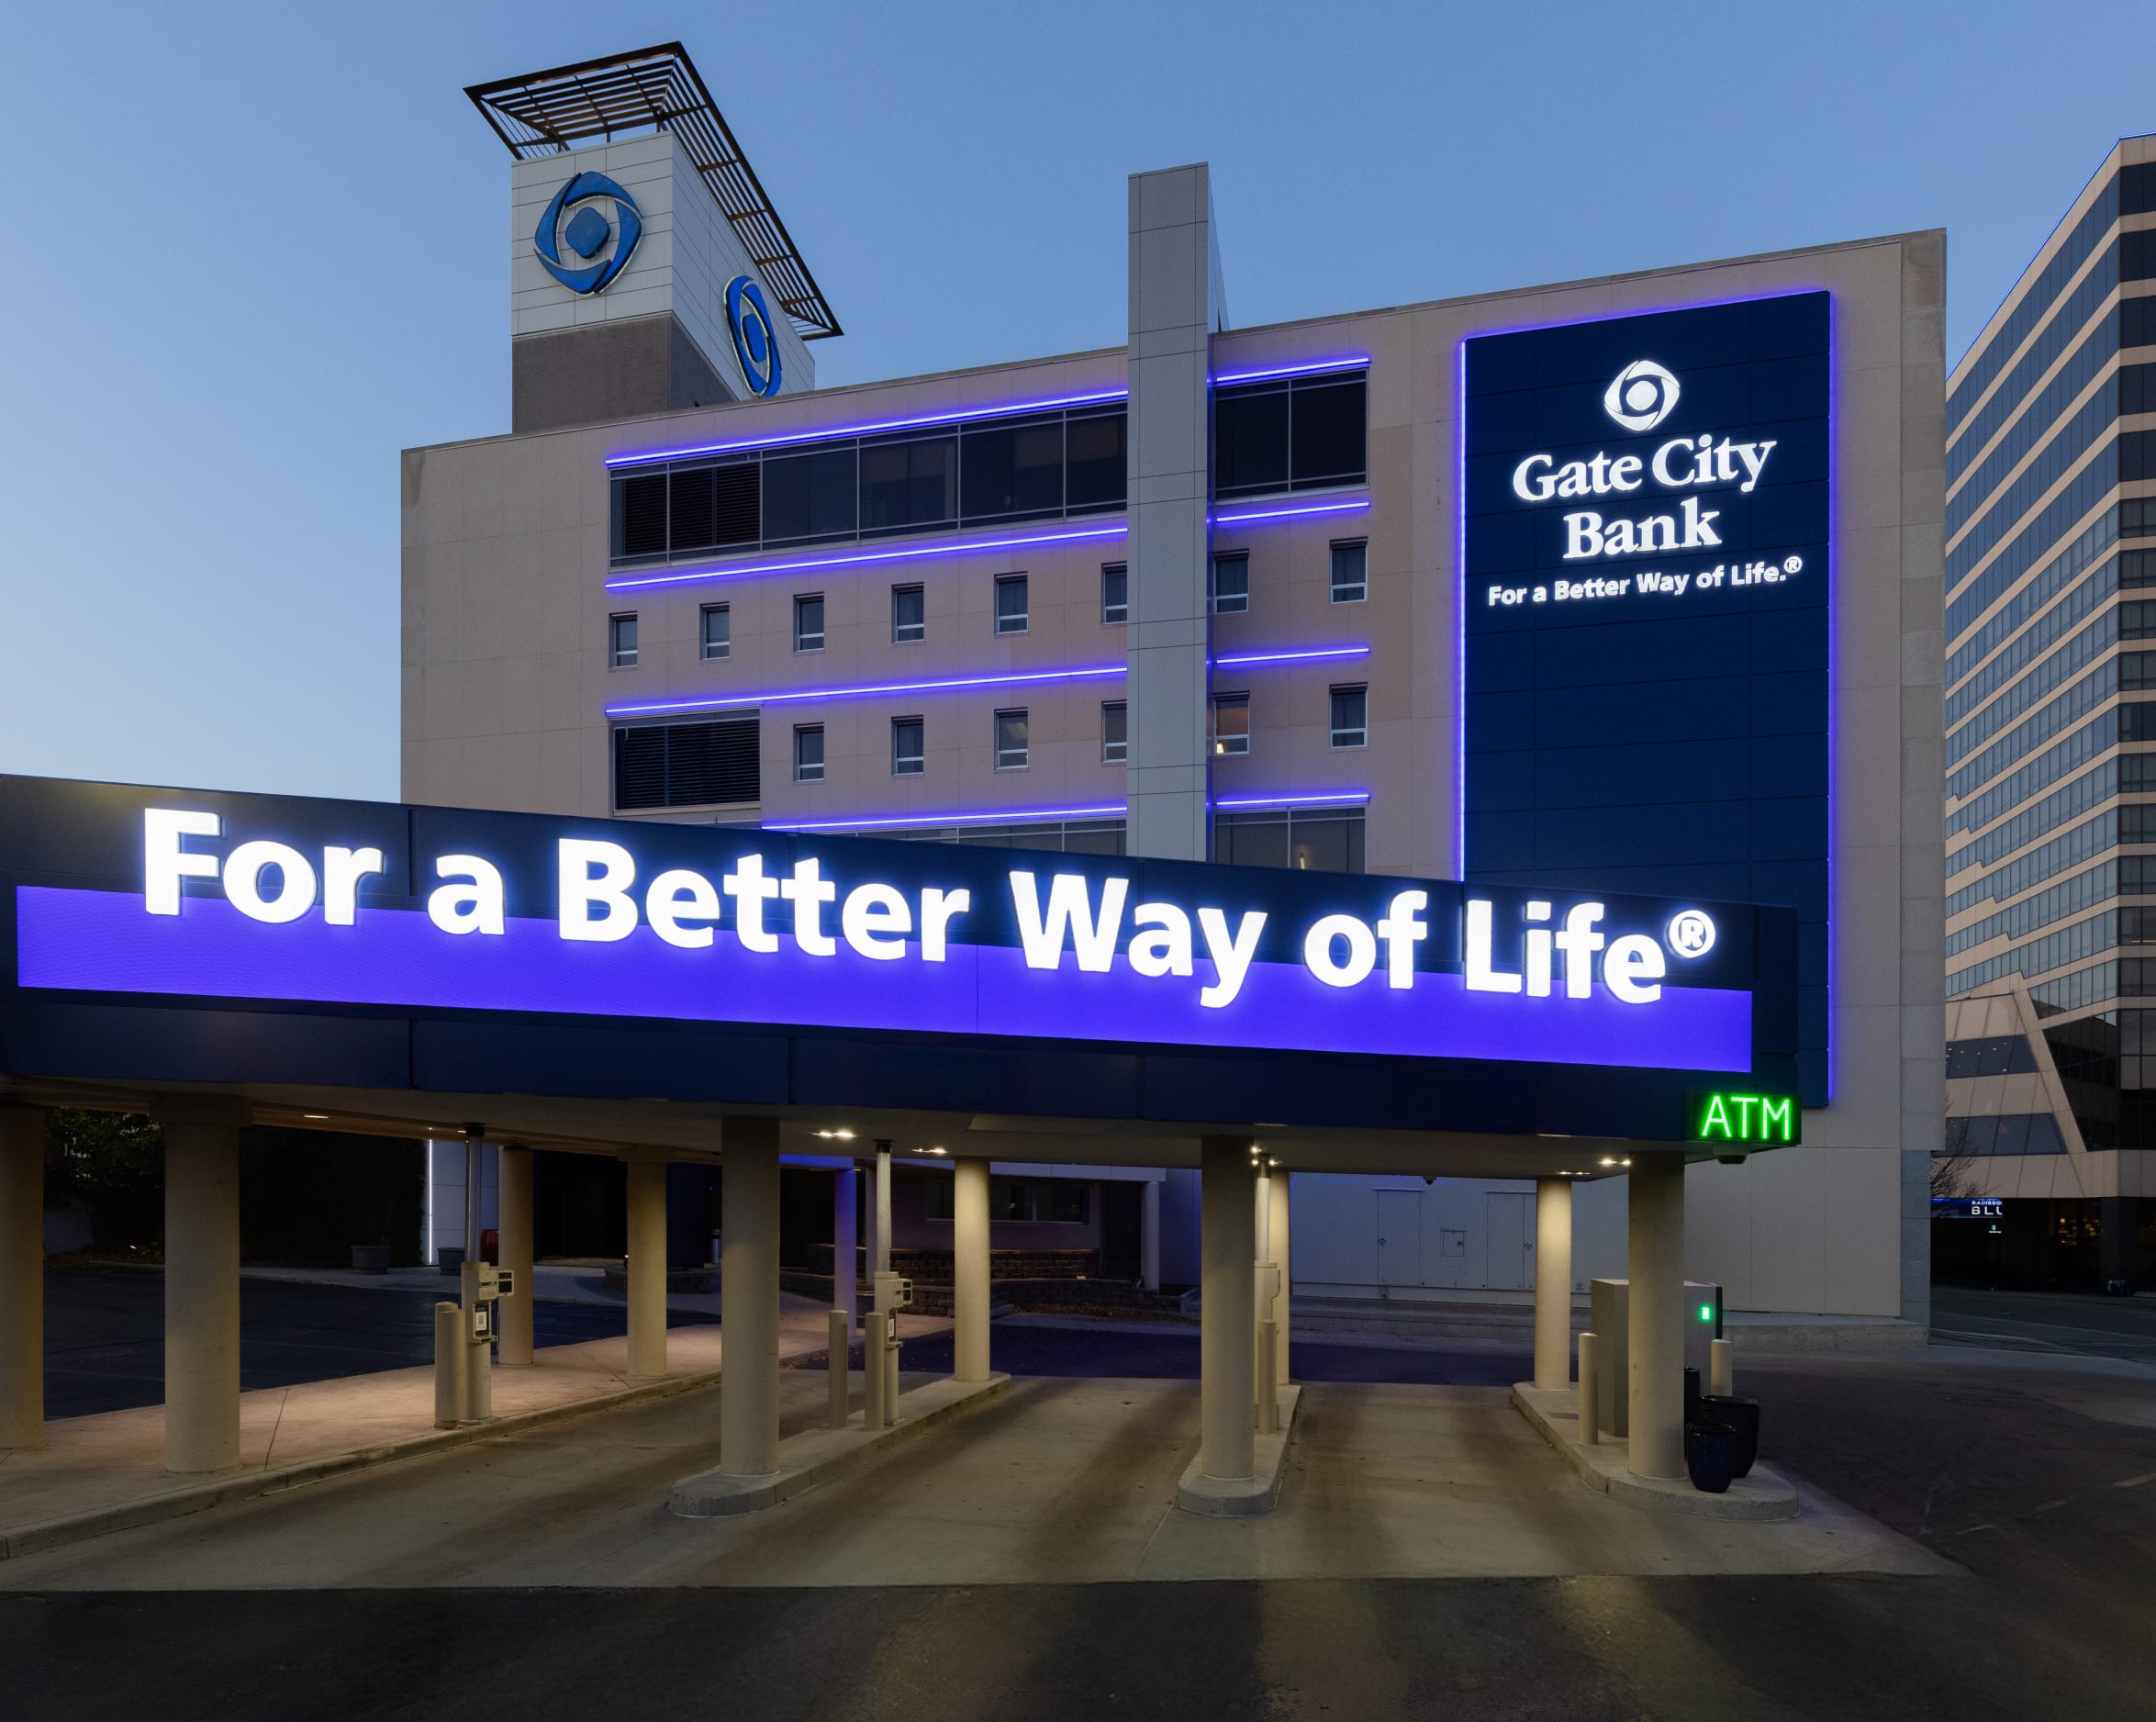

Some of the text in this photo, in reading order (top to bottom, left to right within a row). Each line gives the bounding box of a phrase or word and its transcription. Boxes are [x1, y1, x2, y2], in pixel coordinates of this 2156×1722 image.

[1513, 433, 1778, 502] Gate City
[1562, 496, 1723, 559] Bank
[1488, 585, 1528, 607] For
[1532, 586, 1547, 603] a
[1554, 576, 1631, 601] Better
[1636, 571, 1690, 596] Way
[1695, 565, 1725, 588] of
[144, 808, 383, 925] For
[428, 854, 505, 935] a
[559, 838, 970, 962] Better
[1010, 870, 1268, 1009] Way
[1303, 890, 1428, 990] of
[1701, 1095, 1791, 1140] ATM
